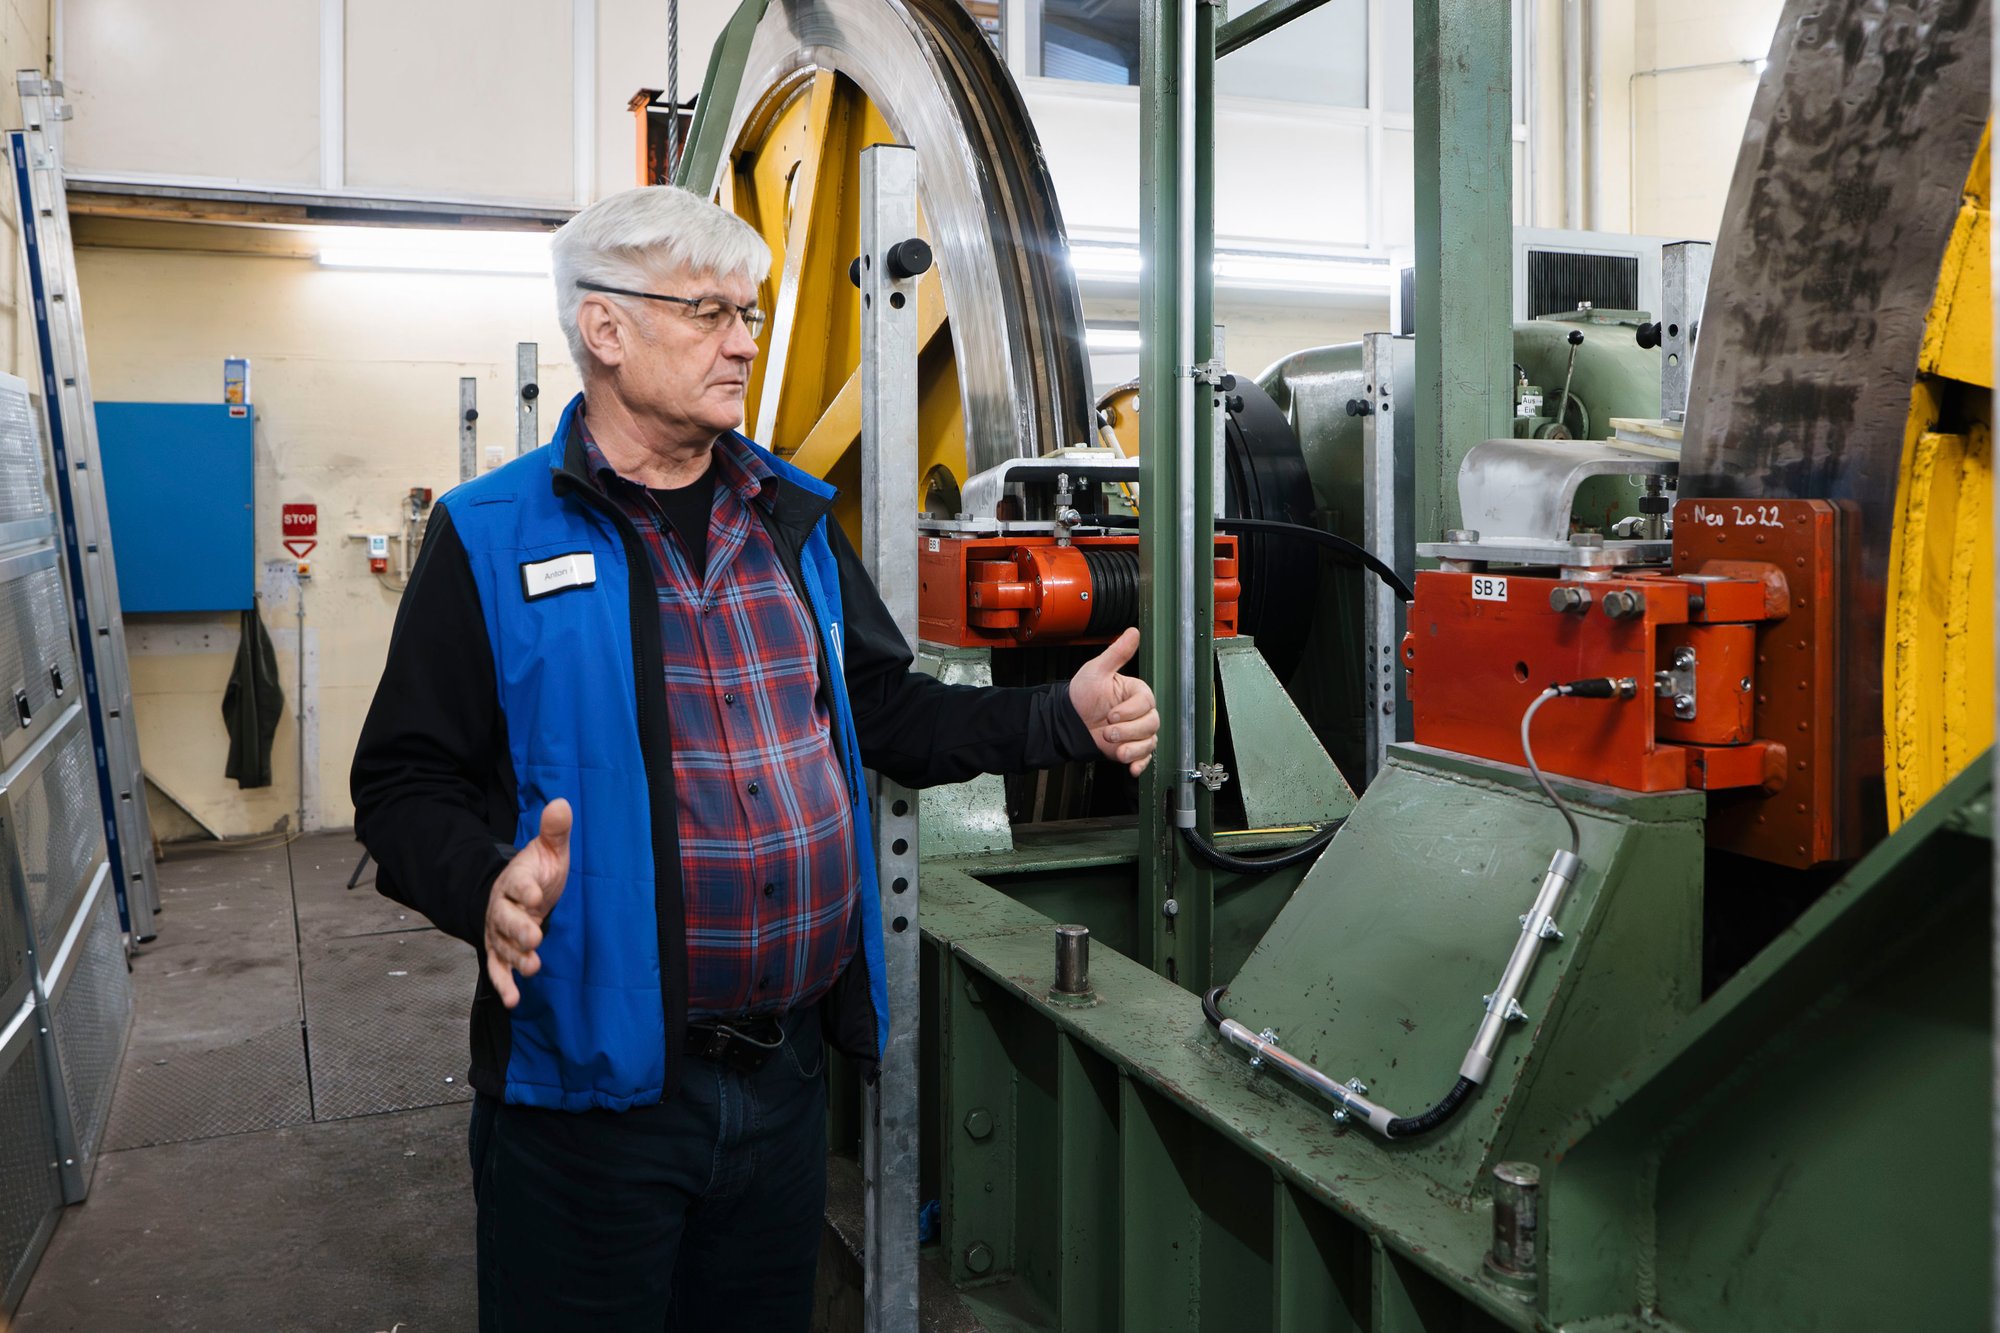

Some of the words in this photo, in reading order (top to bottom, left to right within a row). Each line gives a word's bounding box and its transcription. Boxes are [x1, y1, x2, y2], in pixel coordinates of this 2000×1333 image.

[1524, 406, 1535, 414] Ein
[284, 513, 317, 525] STOP
[1732, 506, 1784, 528] 2022
[545, 569, 567, 581] Anton
[1474, 579, 1494, 596] SB
[1497, 581, 1506, 597] 2
